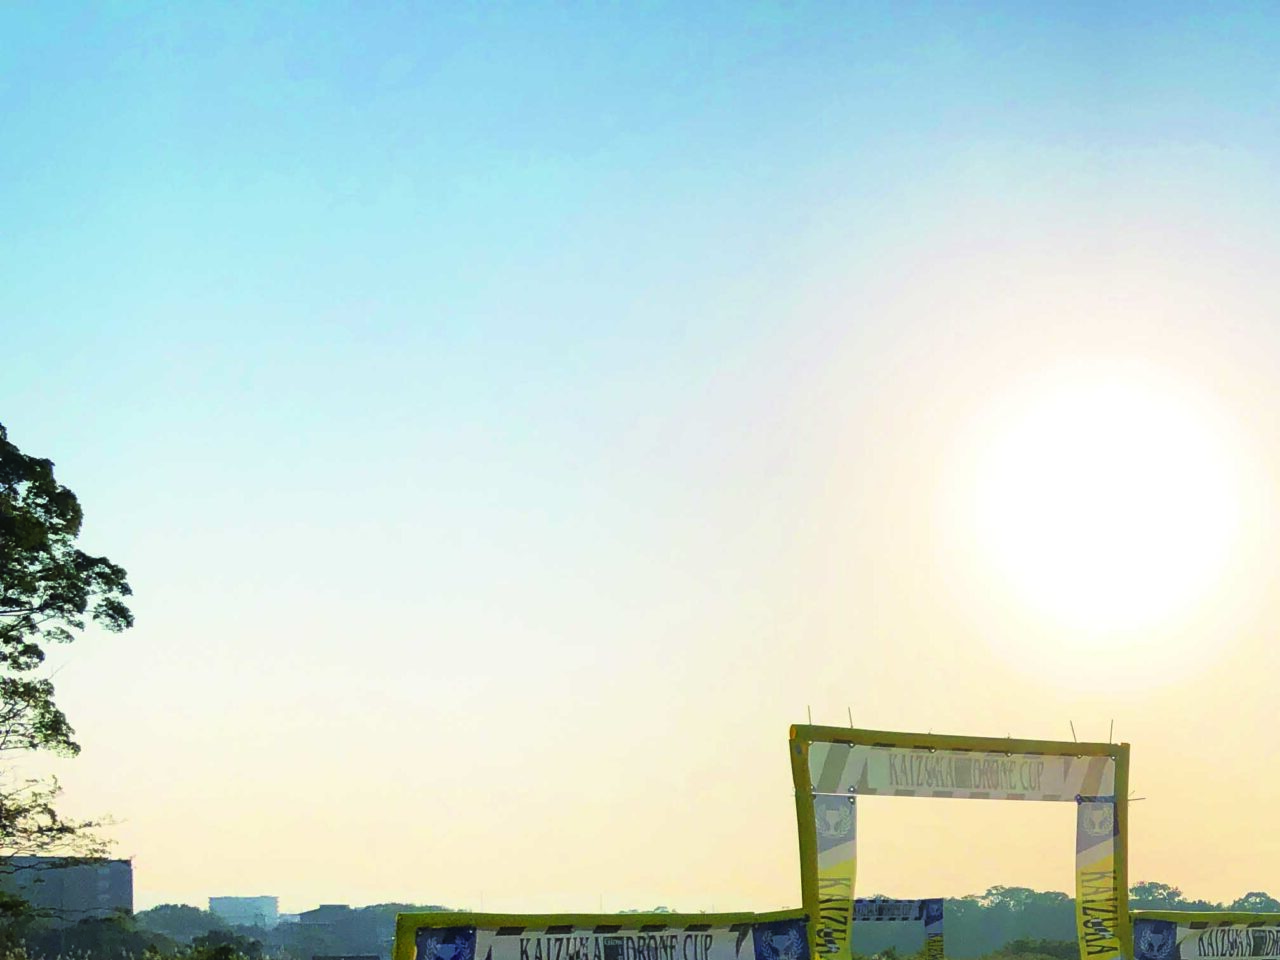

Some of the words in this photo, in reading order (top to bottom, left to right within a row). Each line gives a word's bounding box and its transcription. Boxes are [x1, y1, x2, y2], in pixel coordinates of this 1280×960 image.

[889, 753, 956, 788] KAIZUKA
[972, 758, 1017, 790] DRONE
[1020, 760, 1044, 791] CUP
[1198, 928, 1253, 957] KAIZUKA
